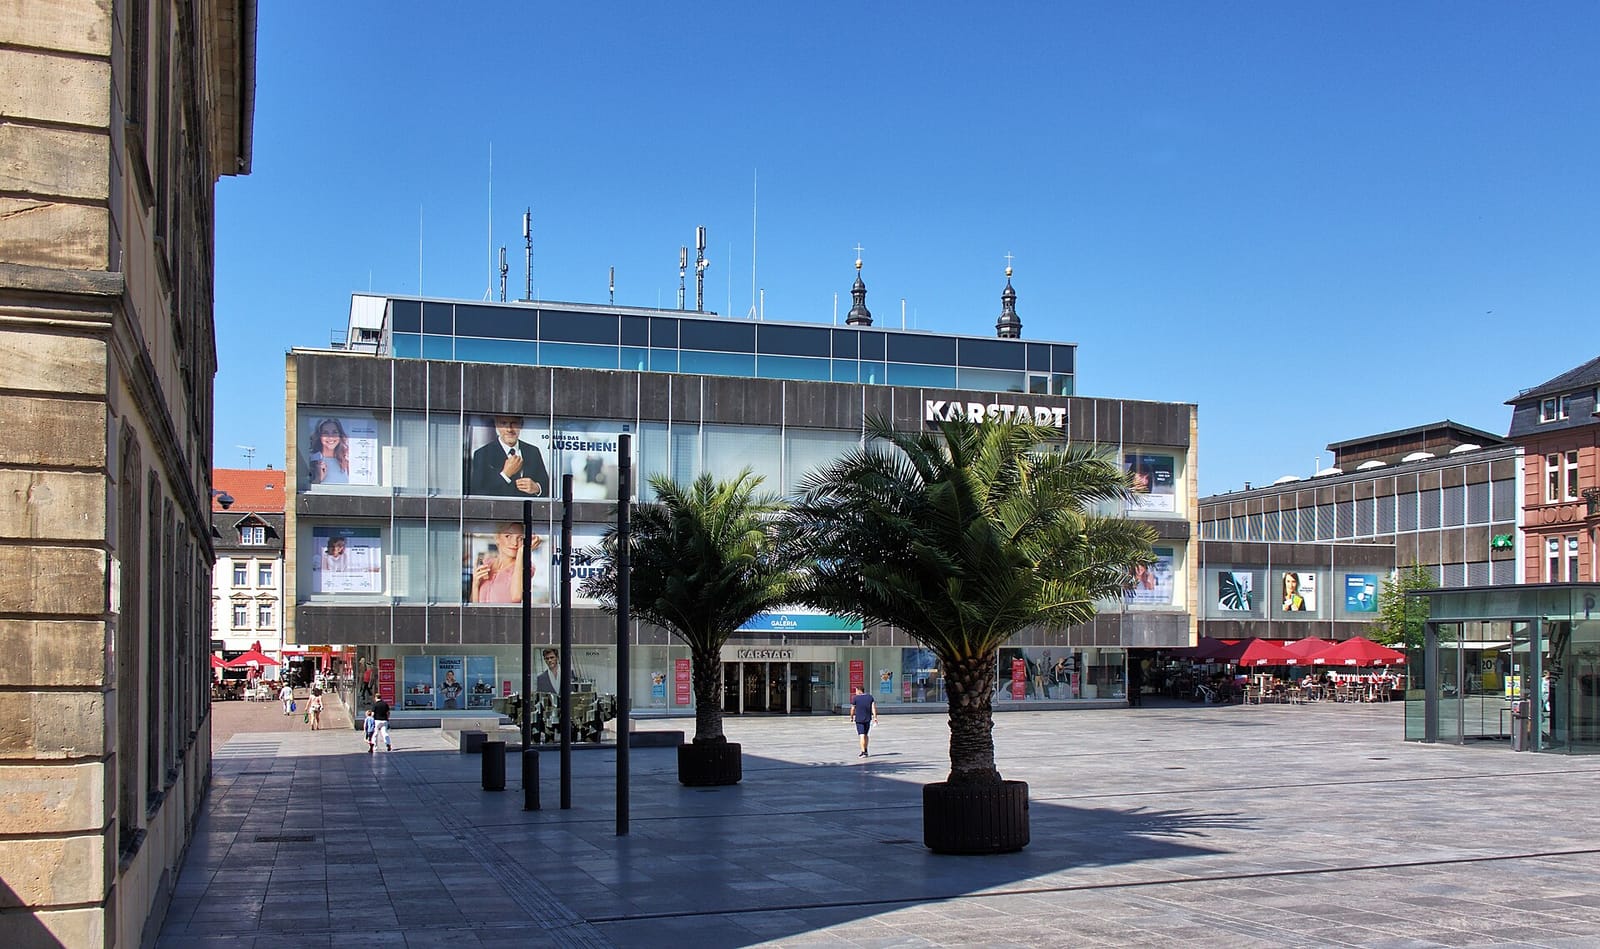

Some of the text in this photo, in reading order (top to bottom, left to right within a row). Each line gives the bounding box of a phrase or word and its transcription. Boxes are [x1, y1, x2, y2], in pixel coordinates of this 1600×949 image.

[925, 399, 1066, 428] KARSTADT
[547, 440, 617, 452] AUSSEHEN!
[770, 619, 798, 627] GALERIA
[737, 649, 793, 659] KARSTADT
